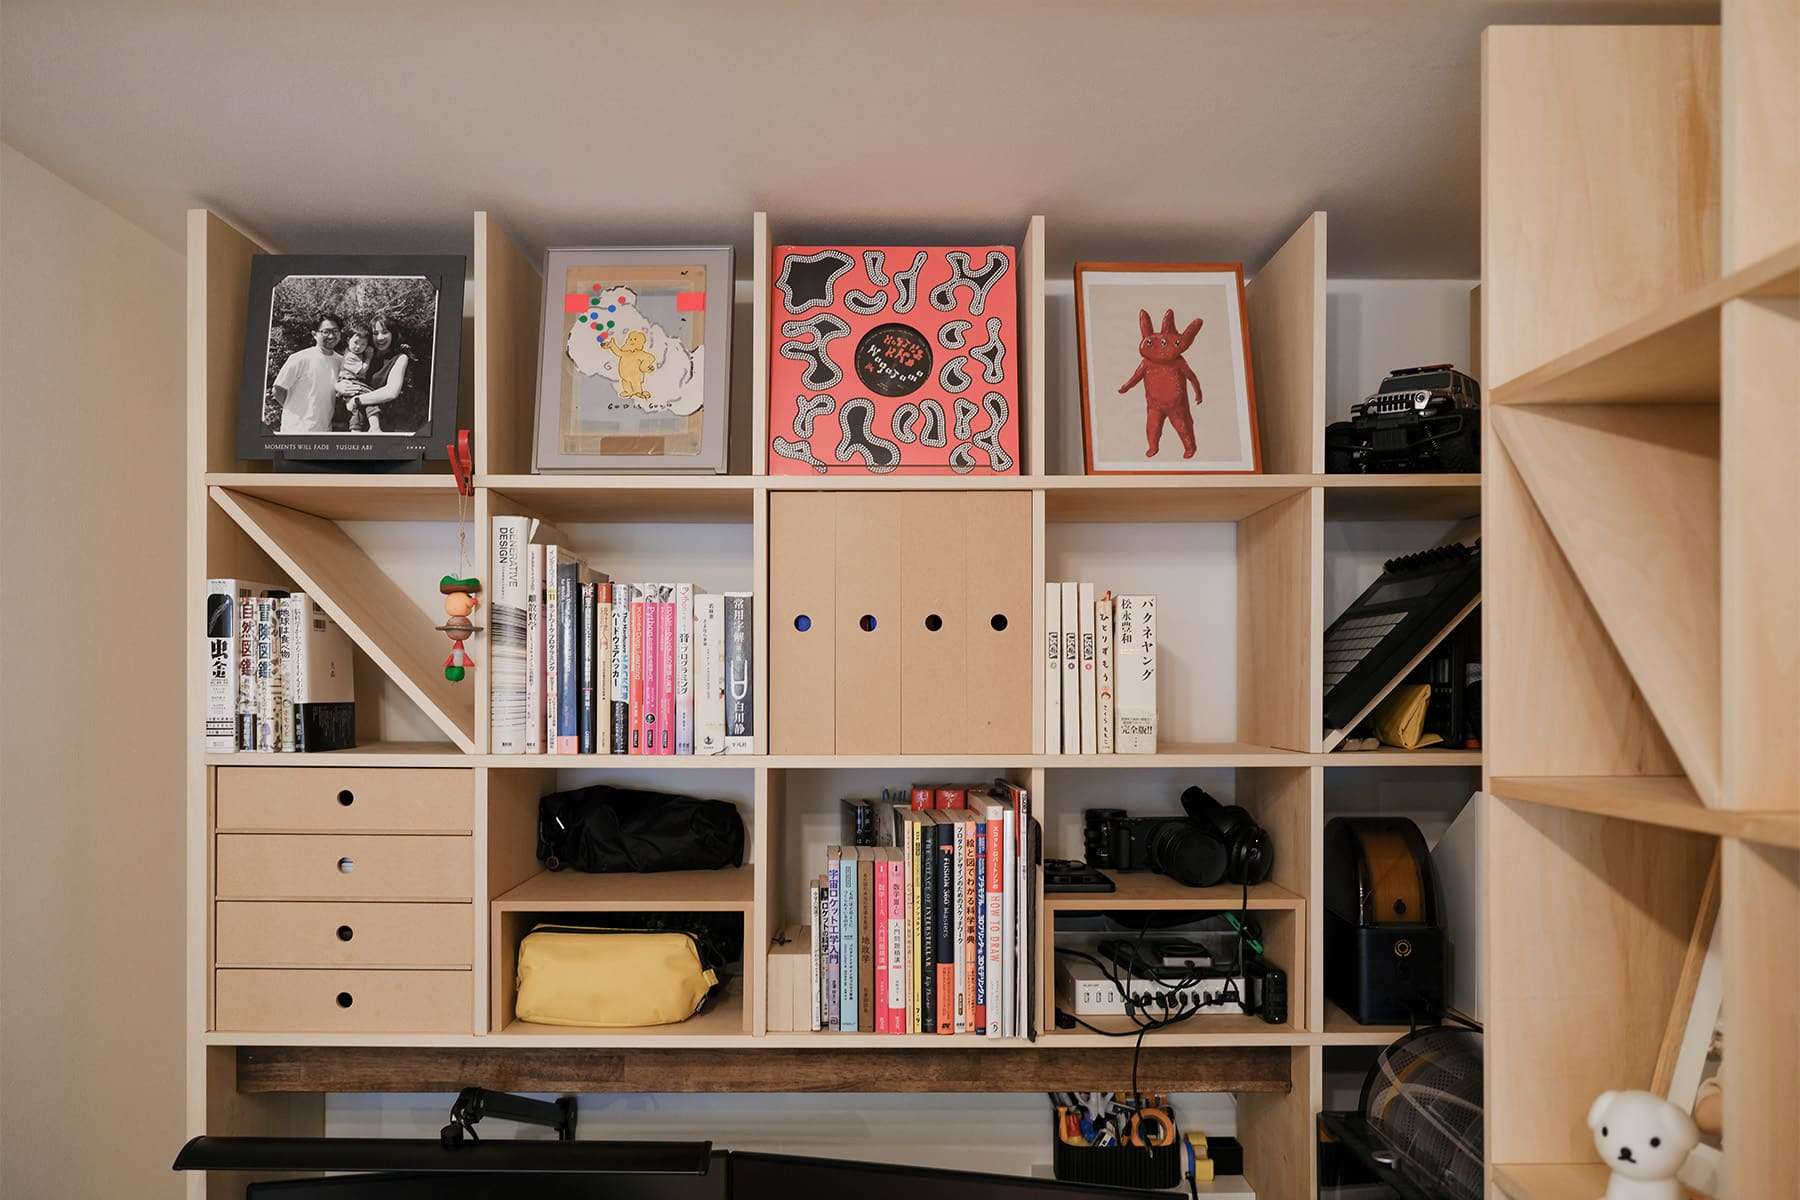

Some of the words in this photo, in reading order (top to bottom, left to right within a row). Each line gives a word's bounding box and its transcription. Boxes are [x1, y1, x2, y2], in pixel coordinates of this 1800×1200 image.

[499, 527, 508, 564] DESIGN
[509, 527, 518, 588] GENERATIVE
[733, 598, 746, 643] 常用字解
[1121, 598, 1132, 644] 松永豊和
[1141, 598, 1154, 681] バクネヤング
[611, 612, 620, 687] ハードウェアハッカー
[1099, 613, 1110, 682] ひとりずもう
[733, 701, 746, 735] 白川静
[966, 838, 975, 944] 絵と図でわかる科学事典
[990, 895, 1001, 917] HOW
[821, 902, 829, 953] ロケットの科学
[828, 868, 839, 965] 宇宙ロケット工学入門
[990, 920, 1001, 932] TO
[990, 936, 1001, 963] DRAW
